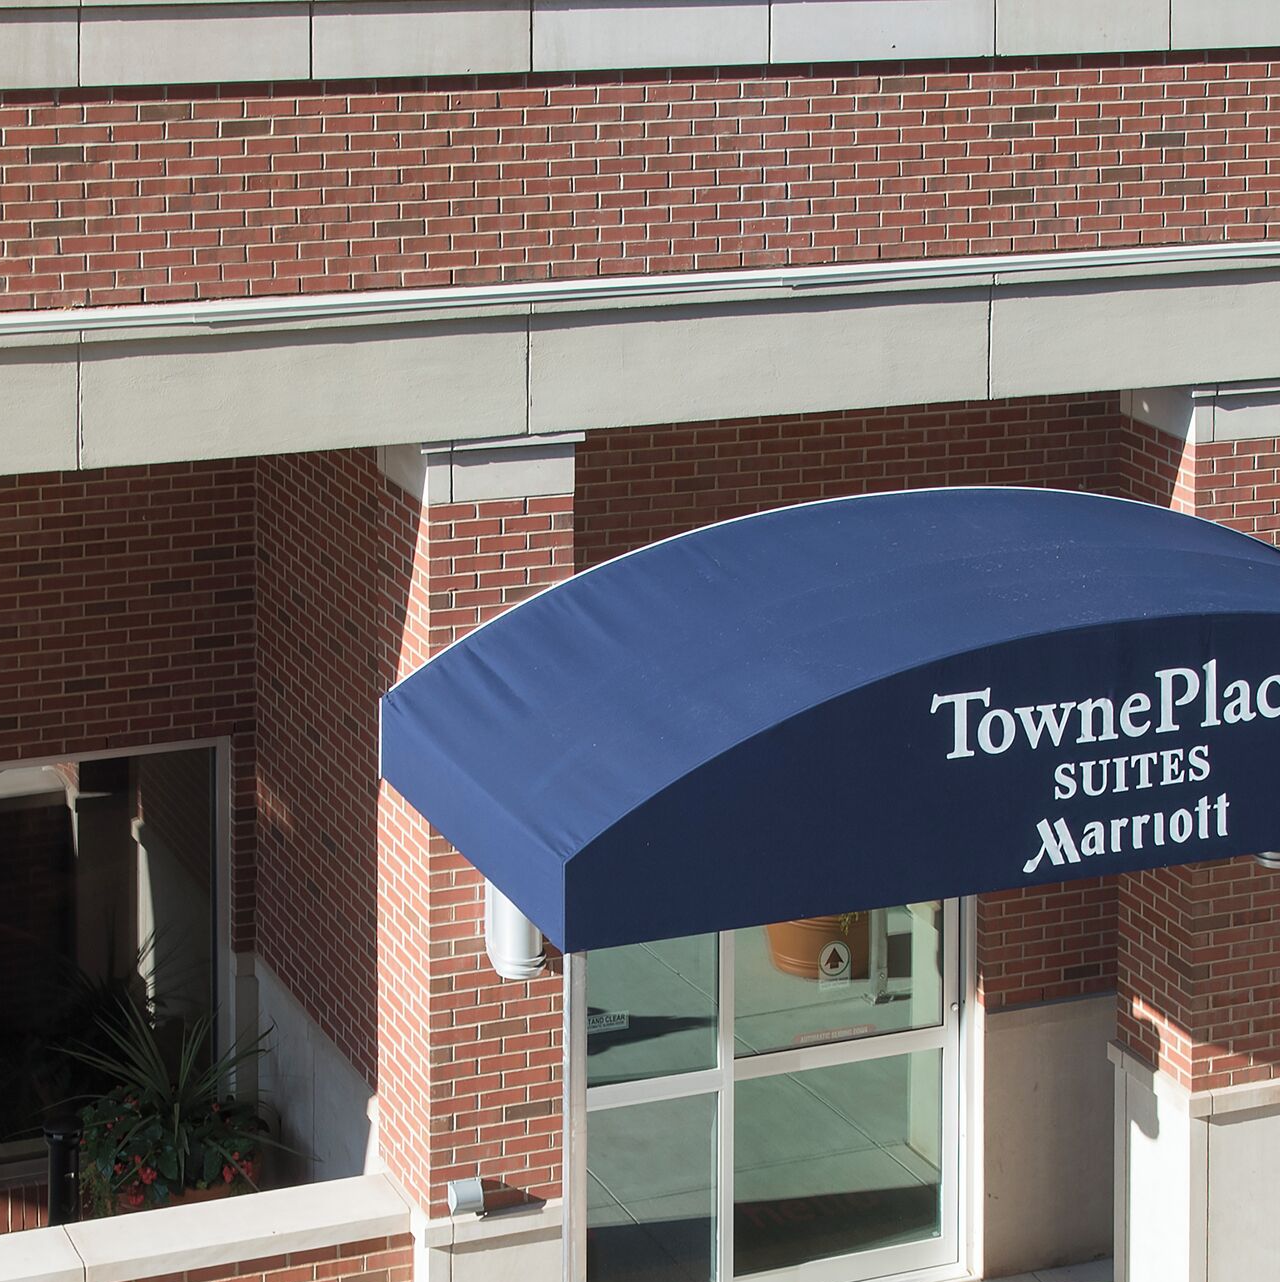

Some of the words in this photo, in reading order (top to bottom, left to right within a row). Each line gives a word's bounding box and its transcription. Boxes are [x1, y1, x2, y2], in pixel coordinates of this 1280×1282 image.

[1053, 745, 1211, 800] SUITES
[1022, 792, 1230, 873] Marriott
[605, 1013, 626, 1023] CLEAR
